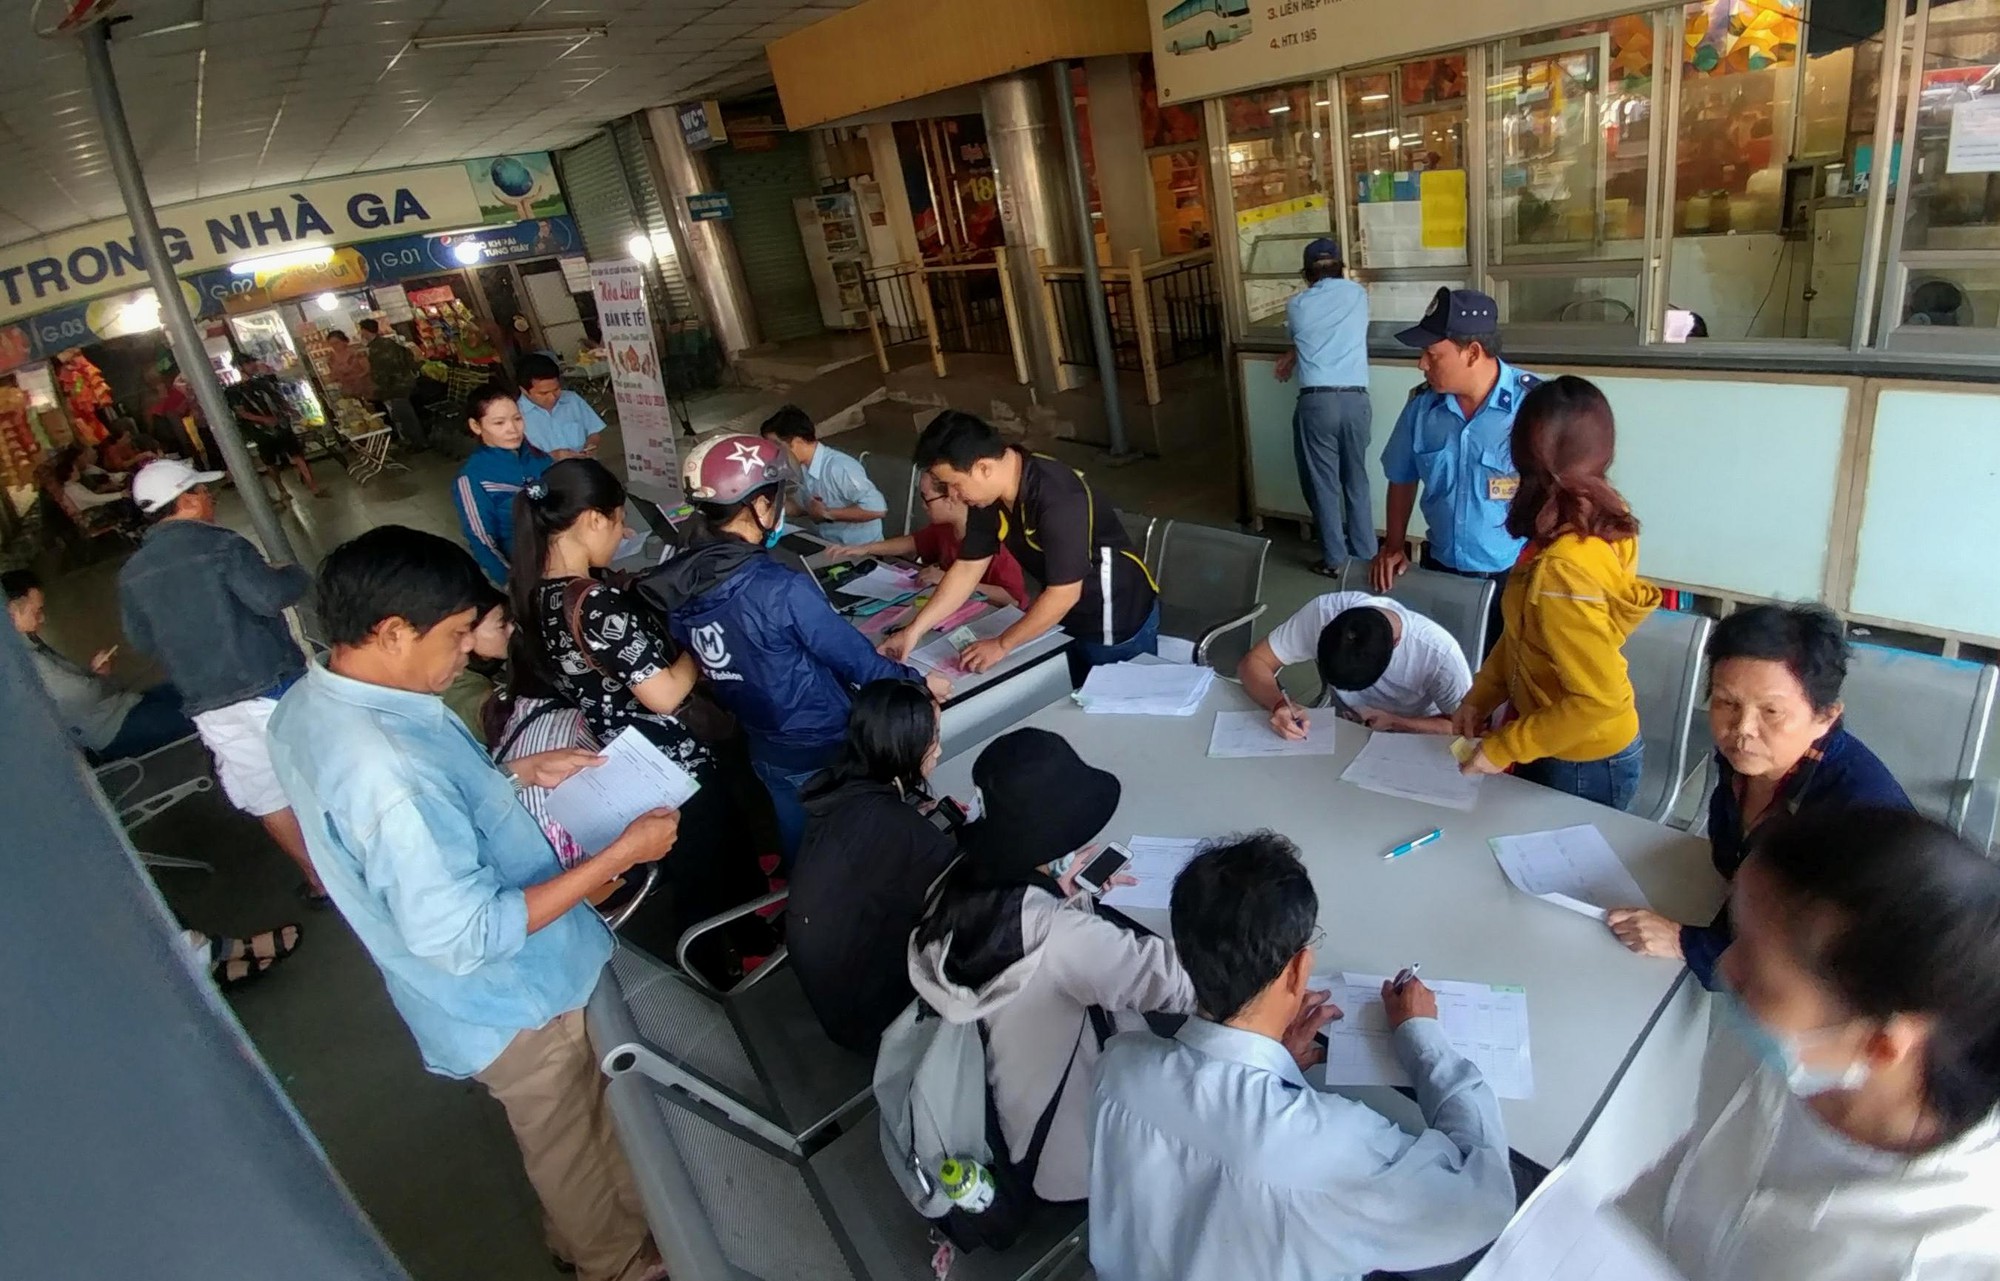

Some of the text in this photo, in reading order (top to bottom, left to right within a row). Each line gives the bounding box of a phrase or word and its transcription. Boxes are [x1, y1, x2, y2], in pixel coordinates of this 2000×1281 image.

[1281, 32, 1299, 47] HTX
[680, 109, 700, 131] WC
[0, 188, 431, 306] TRONG NHÀ GA
[381, 247, 421, 268] G.01
[41, 318, 85, 343] G.03
